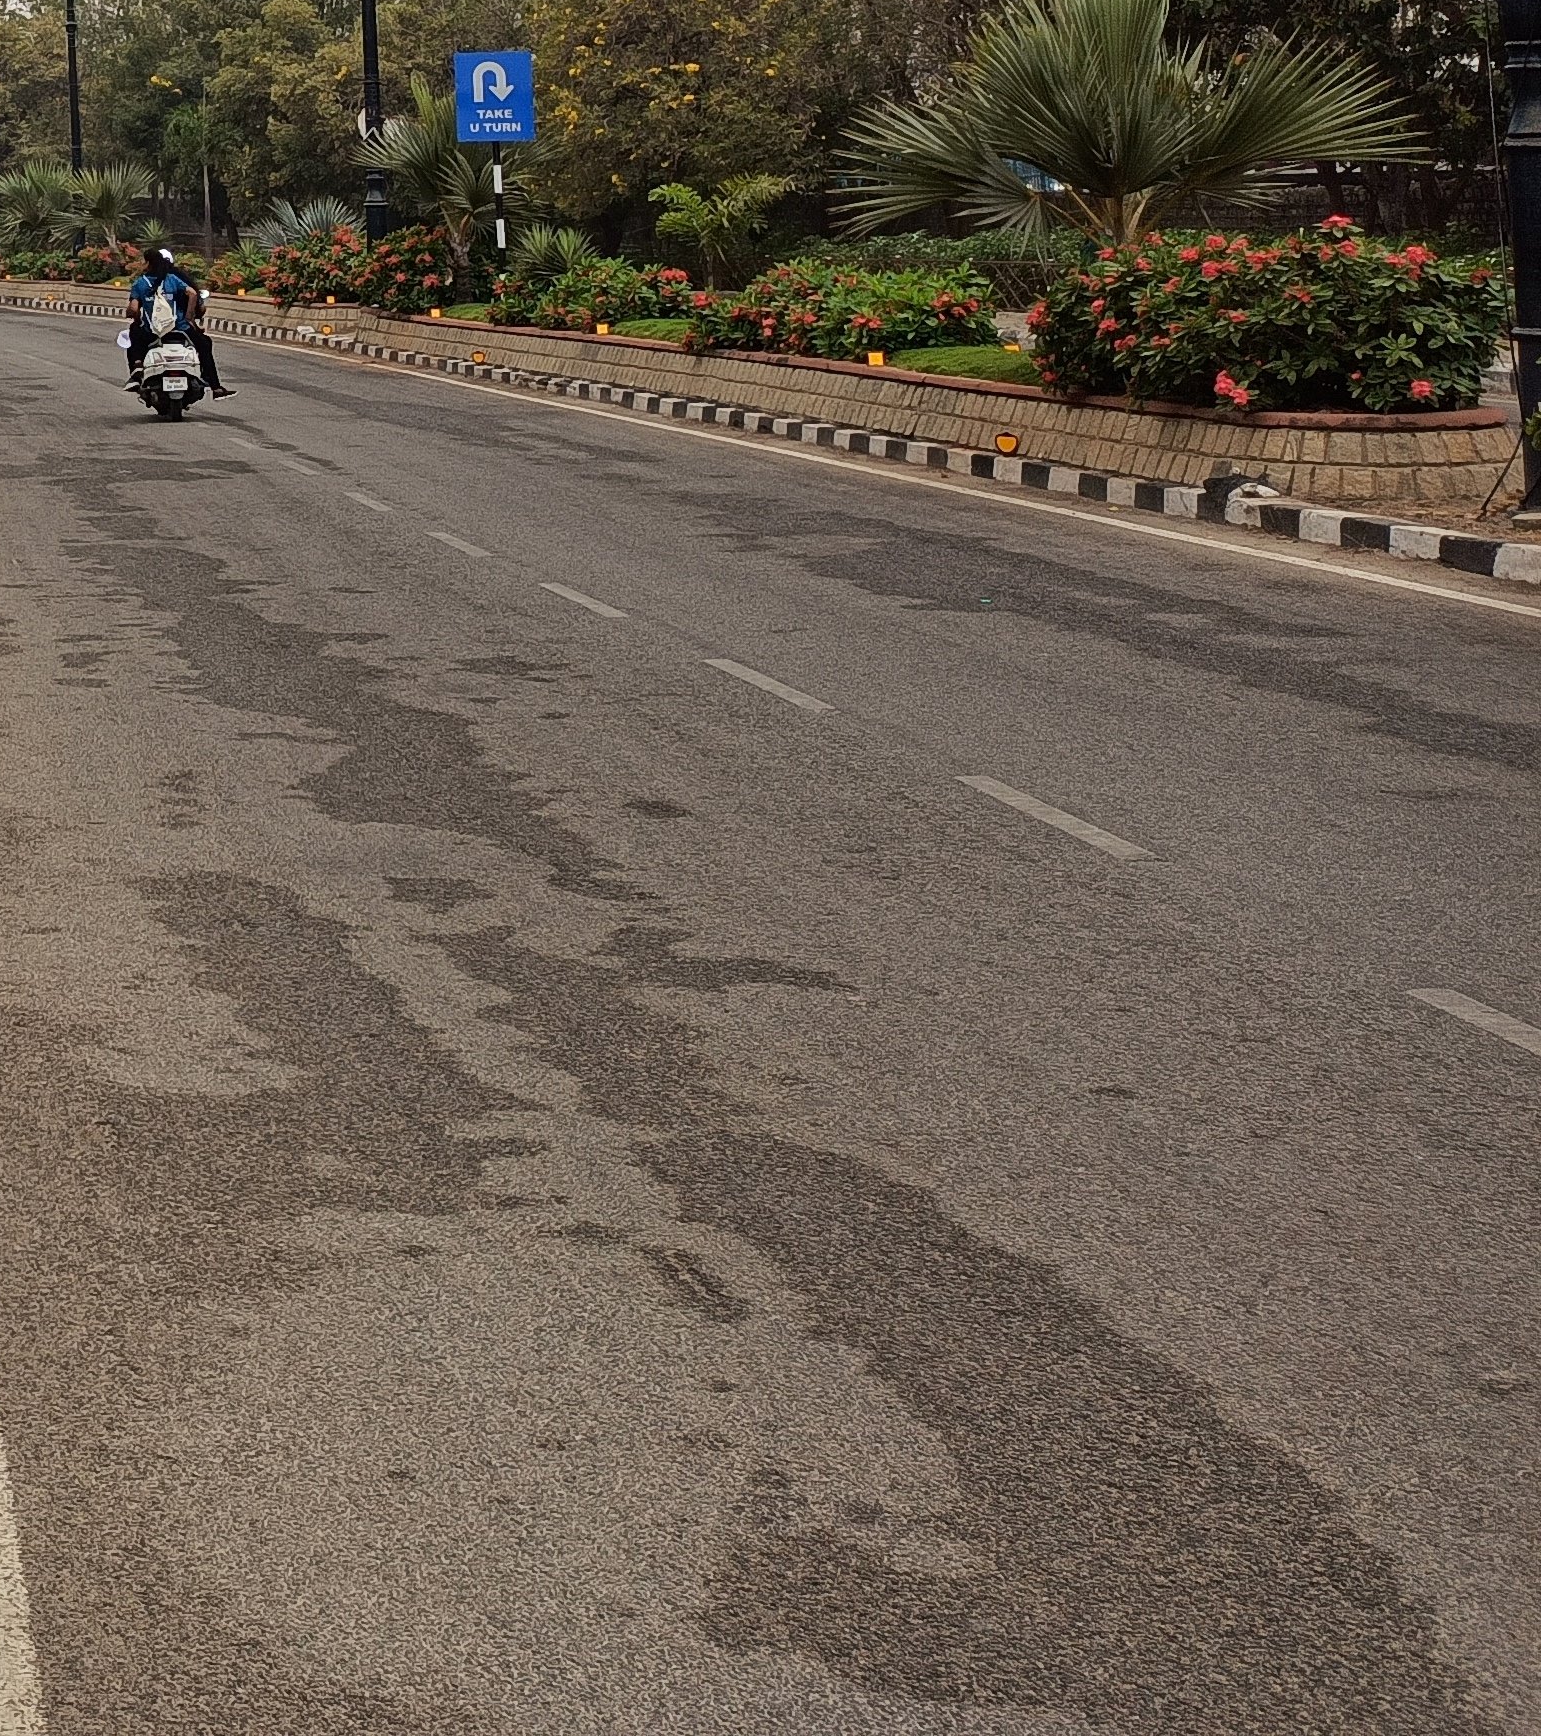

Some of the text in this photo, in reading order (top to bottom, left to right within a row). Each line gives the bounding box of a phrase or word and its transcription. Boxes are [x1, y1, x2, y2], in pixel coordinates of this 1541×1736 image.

[476, 109, 513, 119] TAKE
[469, 122, 521, 133] U TURN
